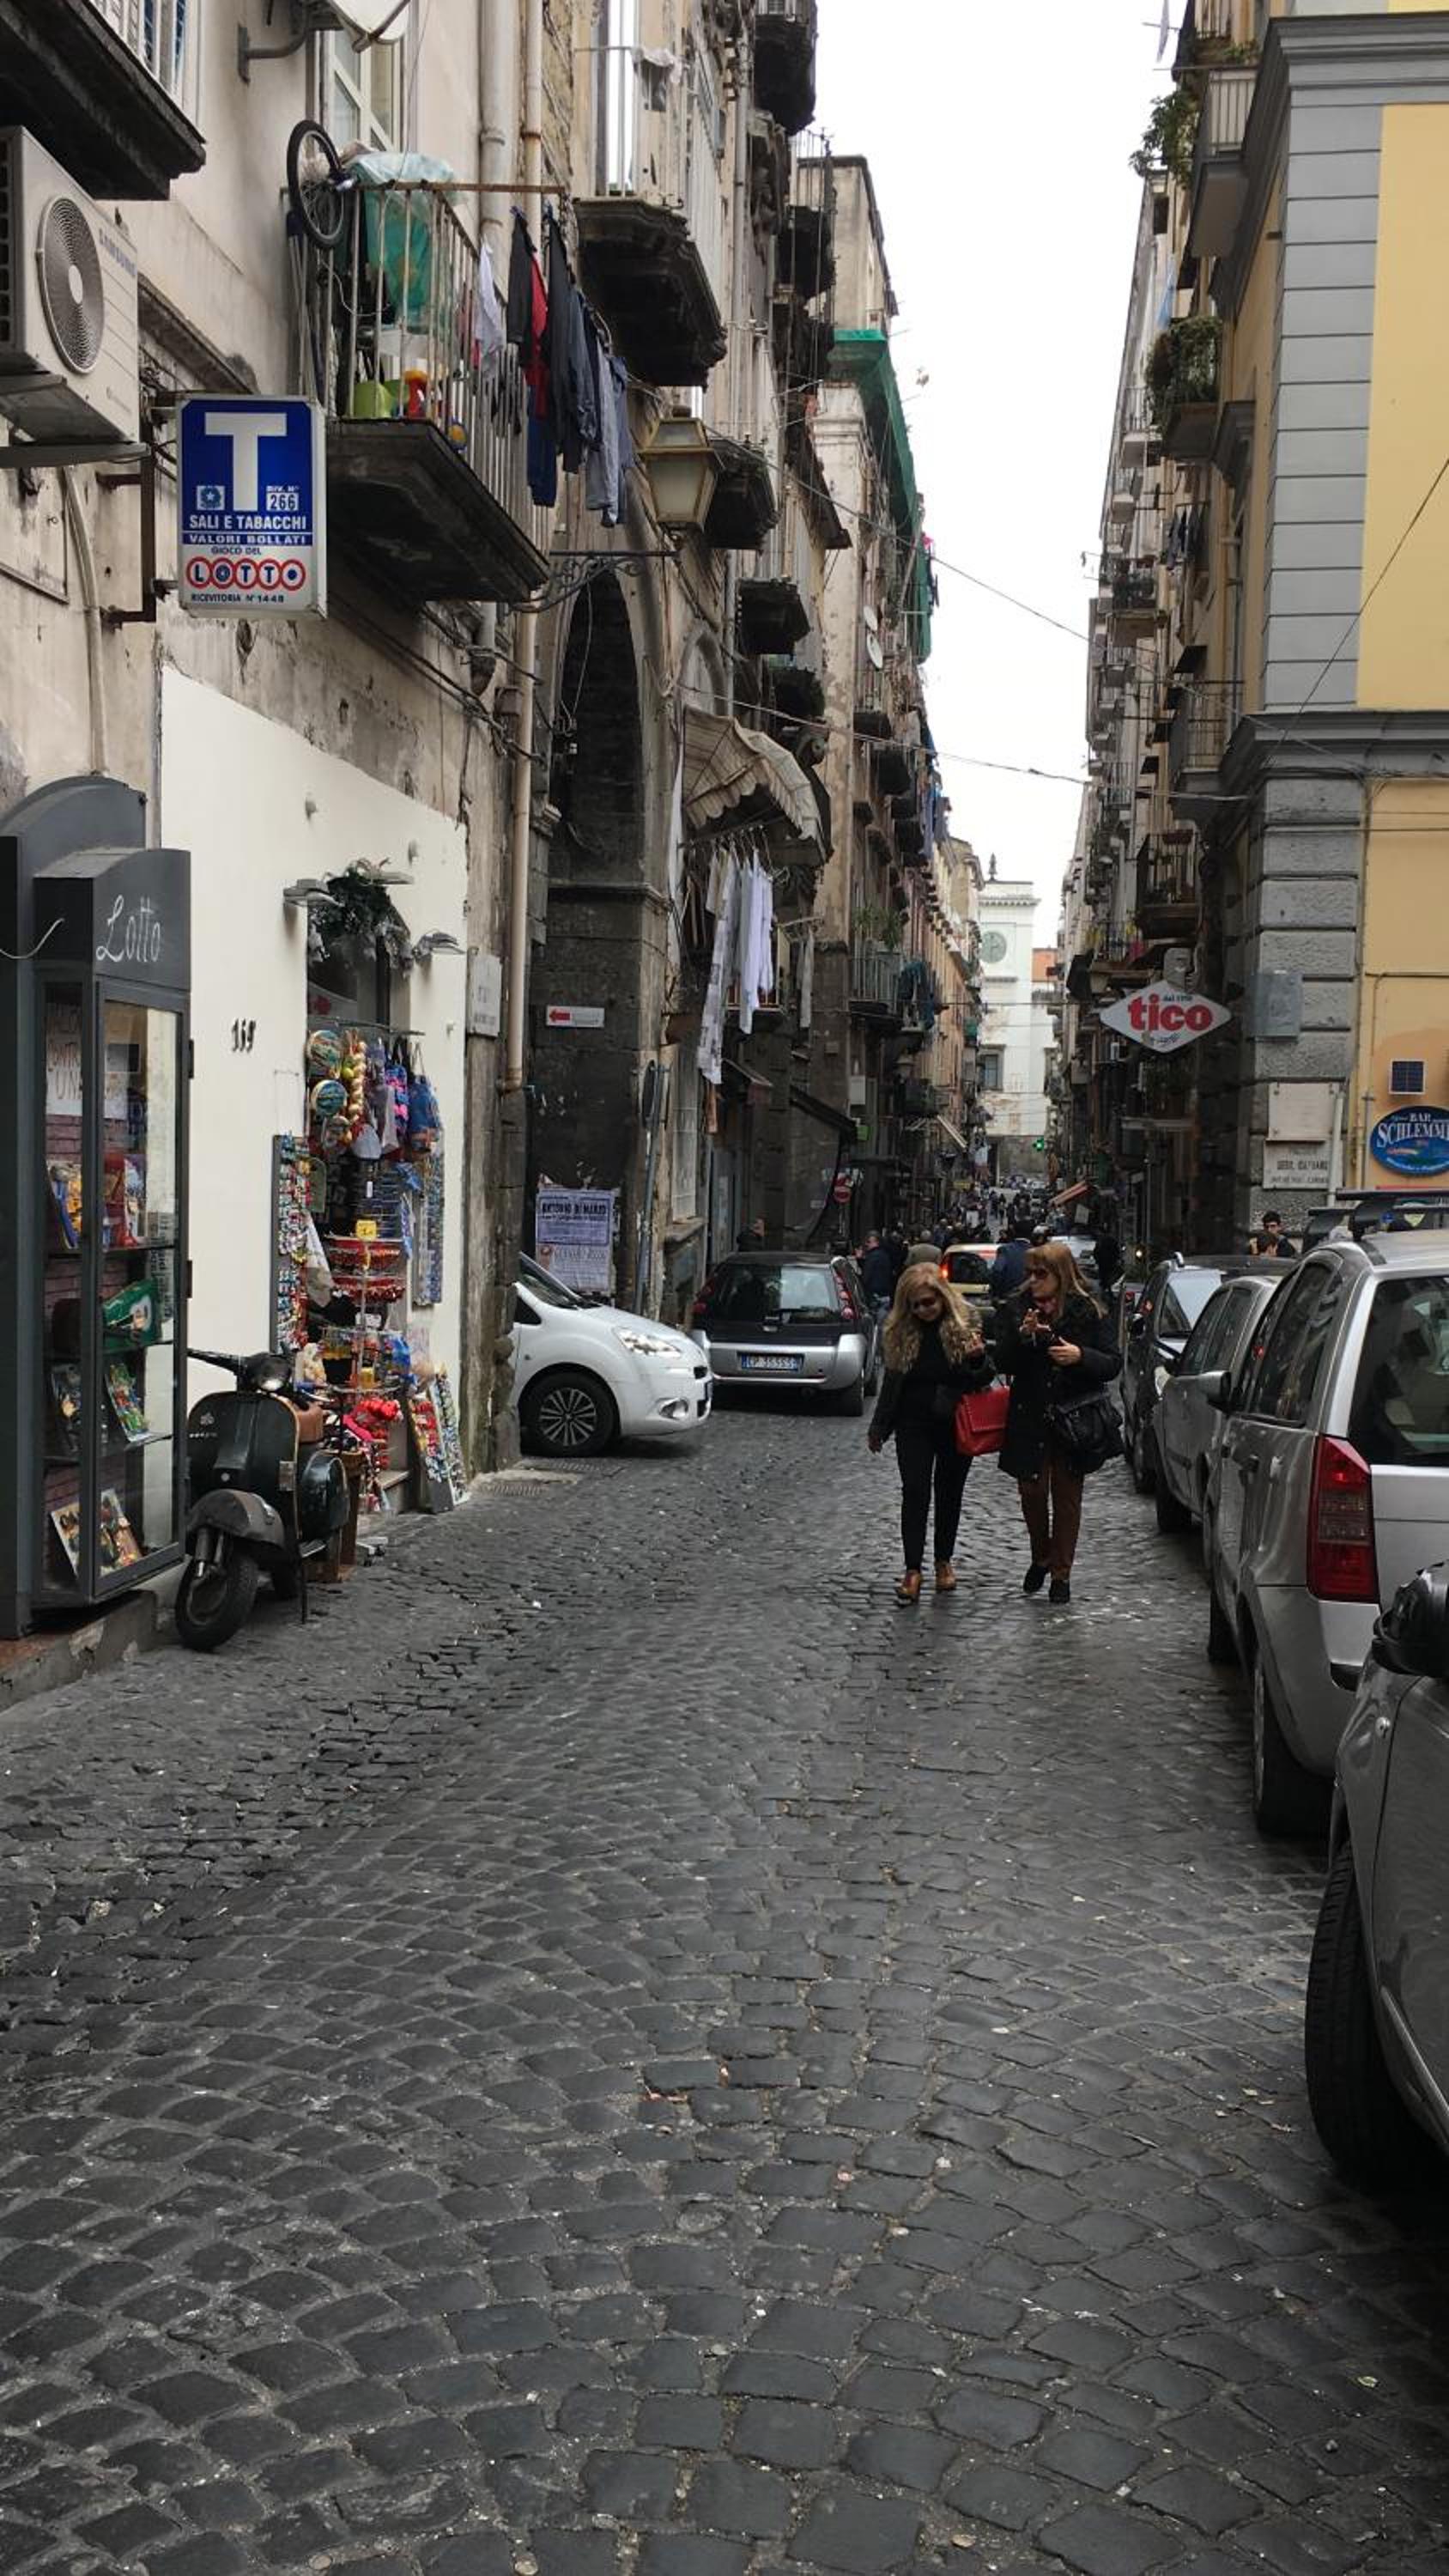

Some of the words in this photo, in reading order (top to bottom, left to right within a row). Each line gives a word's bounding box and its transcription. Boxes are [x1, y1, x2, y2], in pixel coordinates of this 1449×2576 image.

[204, 412, 288, 512] T
[270, 494, 296, 510] 266
[190, 515, 220, 530] SALI
[224, 515, 233, 530] E
[237, 515, 306, 530] TABACCHI
[190, 534, 241, 544] VALORI
[246, 535, 306, 545] BOLLATI
[211, 547, 243, 556] GIOCO
[188, 559, 304, 588] LOTTO
[191, 593, 241, 602] RICEVITORIA
[96, 894, 161, 963] Lotto
[1128, 993, 1213, 1031] tico
[1409, 1112, 1432, 1122] BAR
